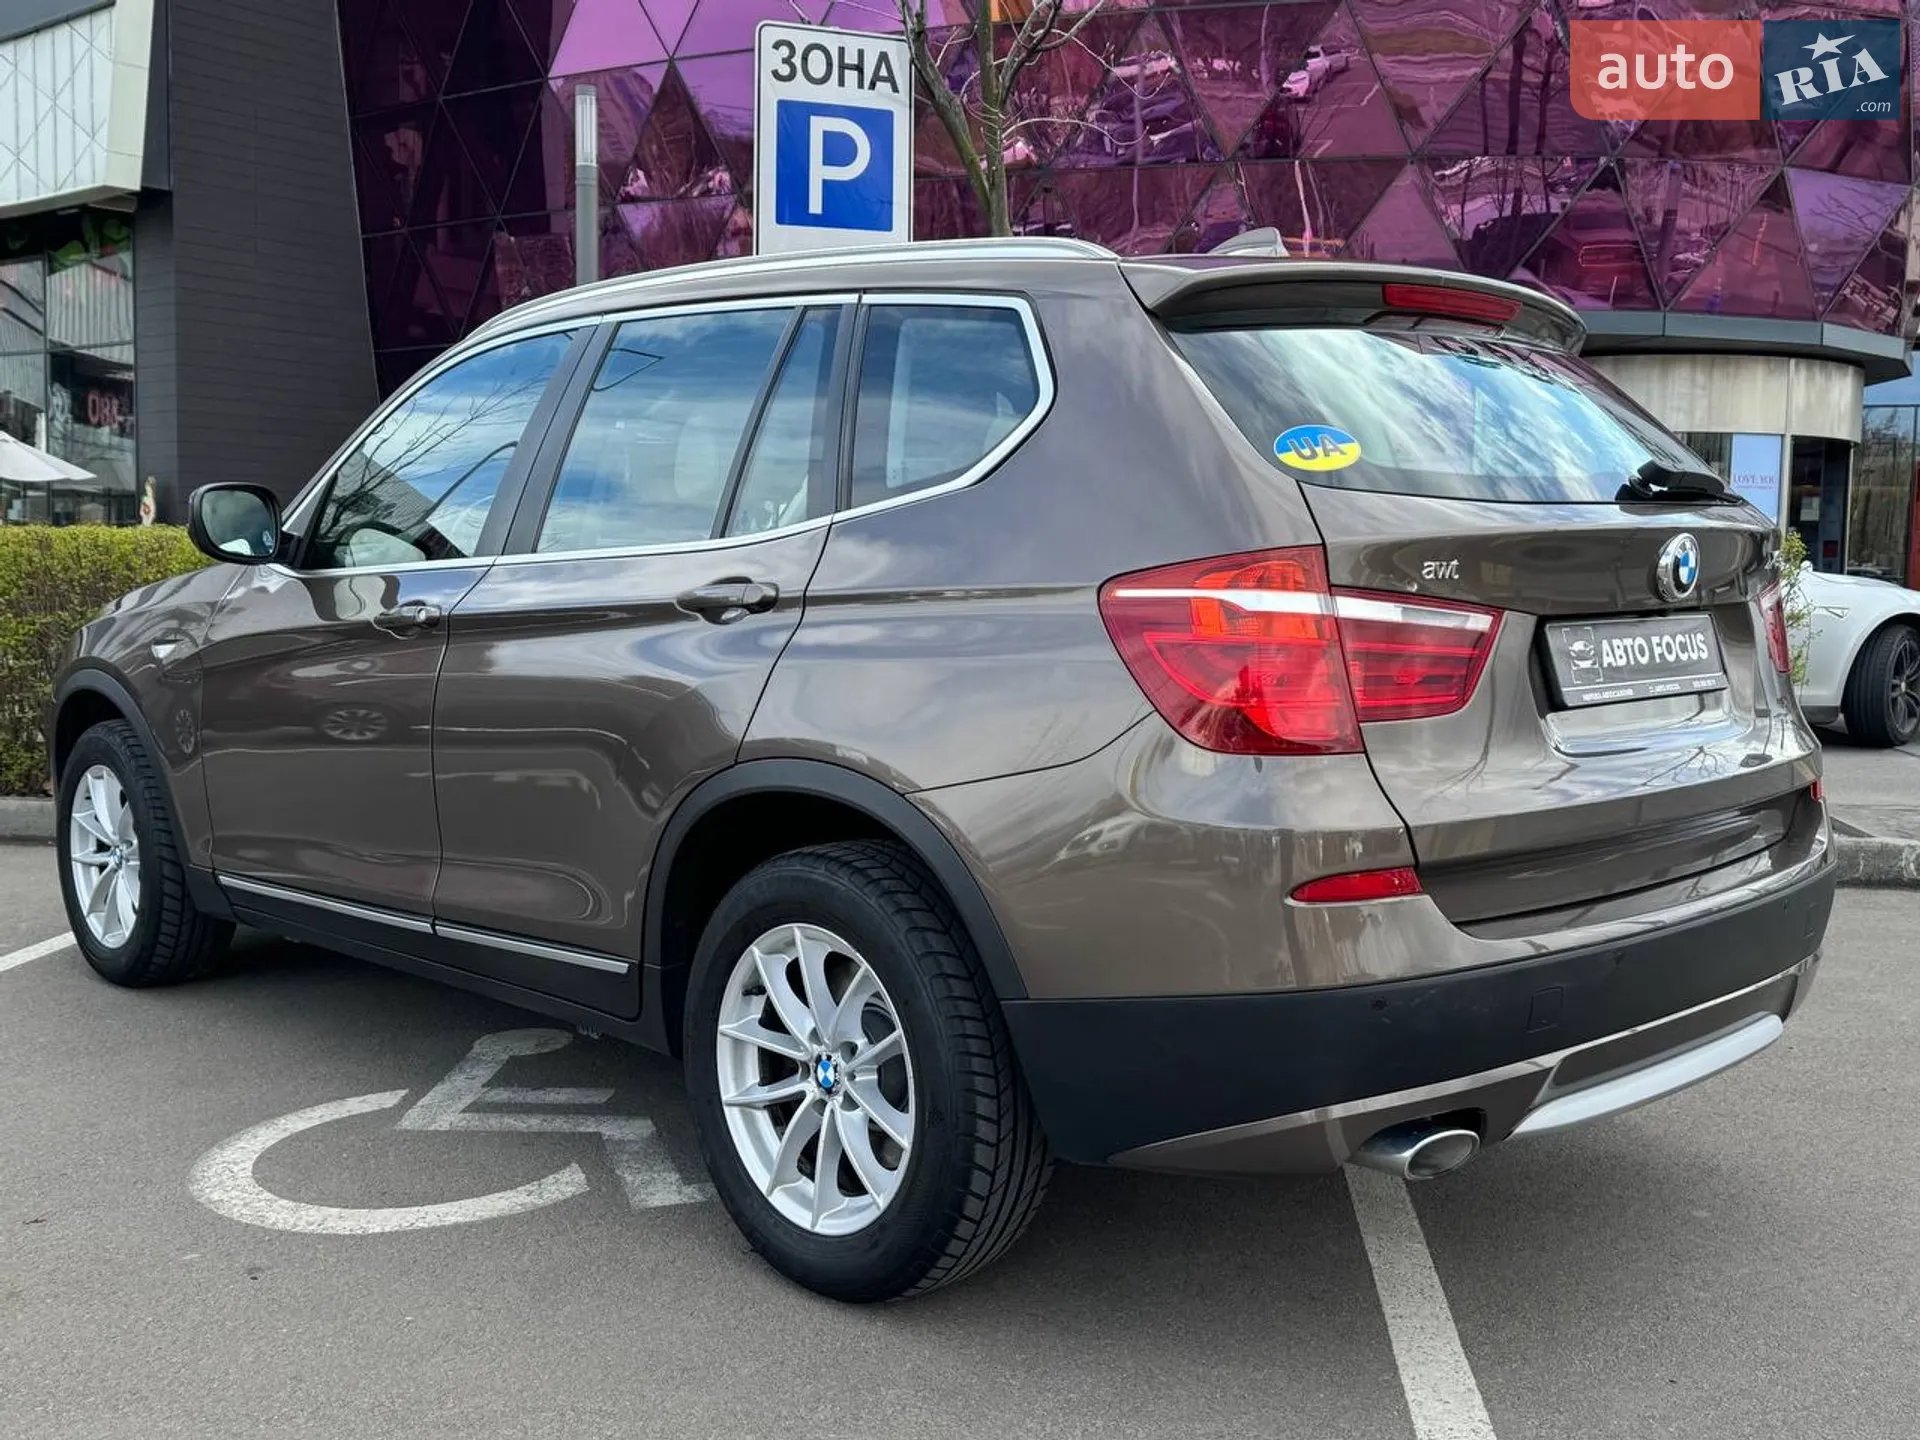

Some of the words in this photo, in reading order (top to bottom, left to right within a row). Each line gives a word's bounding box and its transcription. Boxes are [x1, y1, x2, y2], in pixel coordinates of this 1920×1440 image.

[771, 39, 900, 94] ЗОНА
[808, 115, 871, 215] P
[1286, 432, 1347, 461] UA
[1601, 636, 1650, 668] АВТО
[1650, 633, 1709, 663] FOCUS
